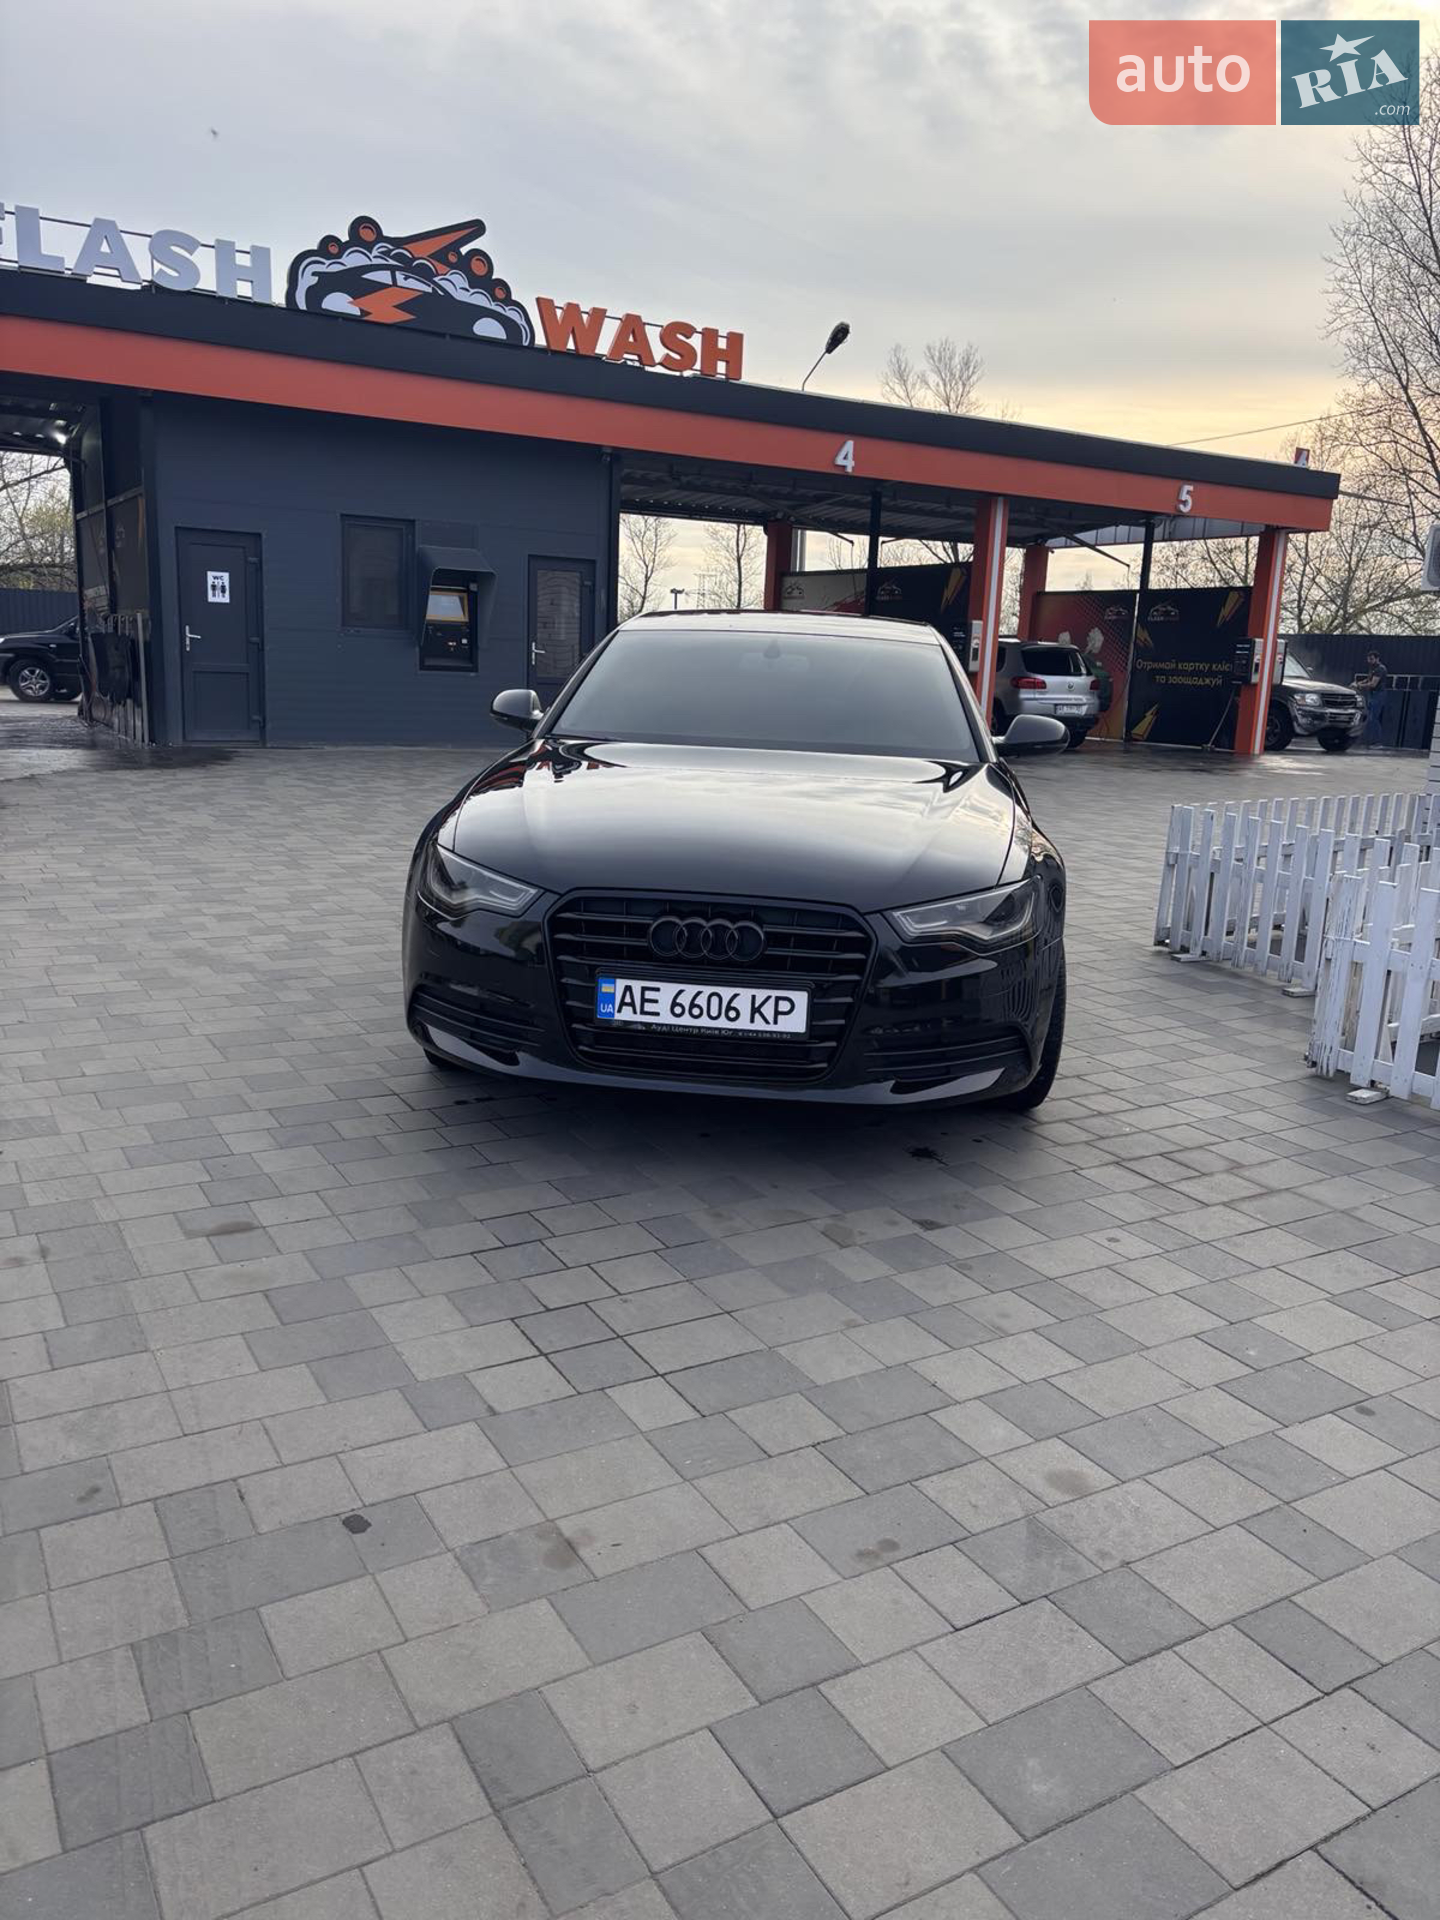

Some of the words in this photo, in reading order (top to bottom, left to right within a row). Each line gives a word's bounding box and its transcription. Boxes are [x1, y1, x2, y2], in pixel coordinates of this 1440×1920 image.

[0, 202, 273, 304] LASH
[535, 297, 745, 380] WASH
[834, 440, 855, 473] 4
[1176, 485, 1194, 514] 5
[1136, 658, 1175, 671] Отримай
[1178, 661, 1209, 672] картку
[1155, 675, 1166, 684] та
[1168, 675, 1223, 687] заощаджуй
[600, 1003, 614, 1013] UA
[616, 984, 661, 1016] AE
[669, 988, 741, 1022] 6606
[749, 994, 796, 1025] KP
